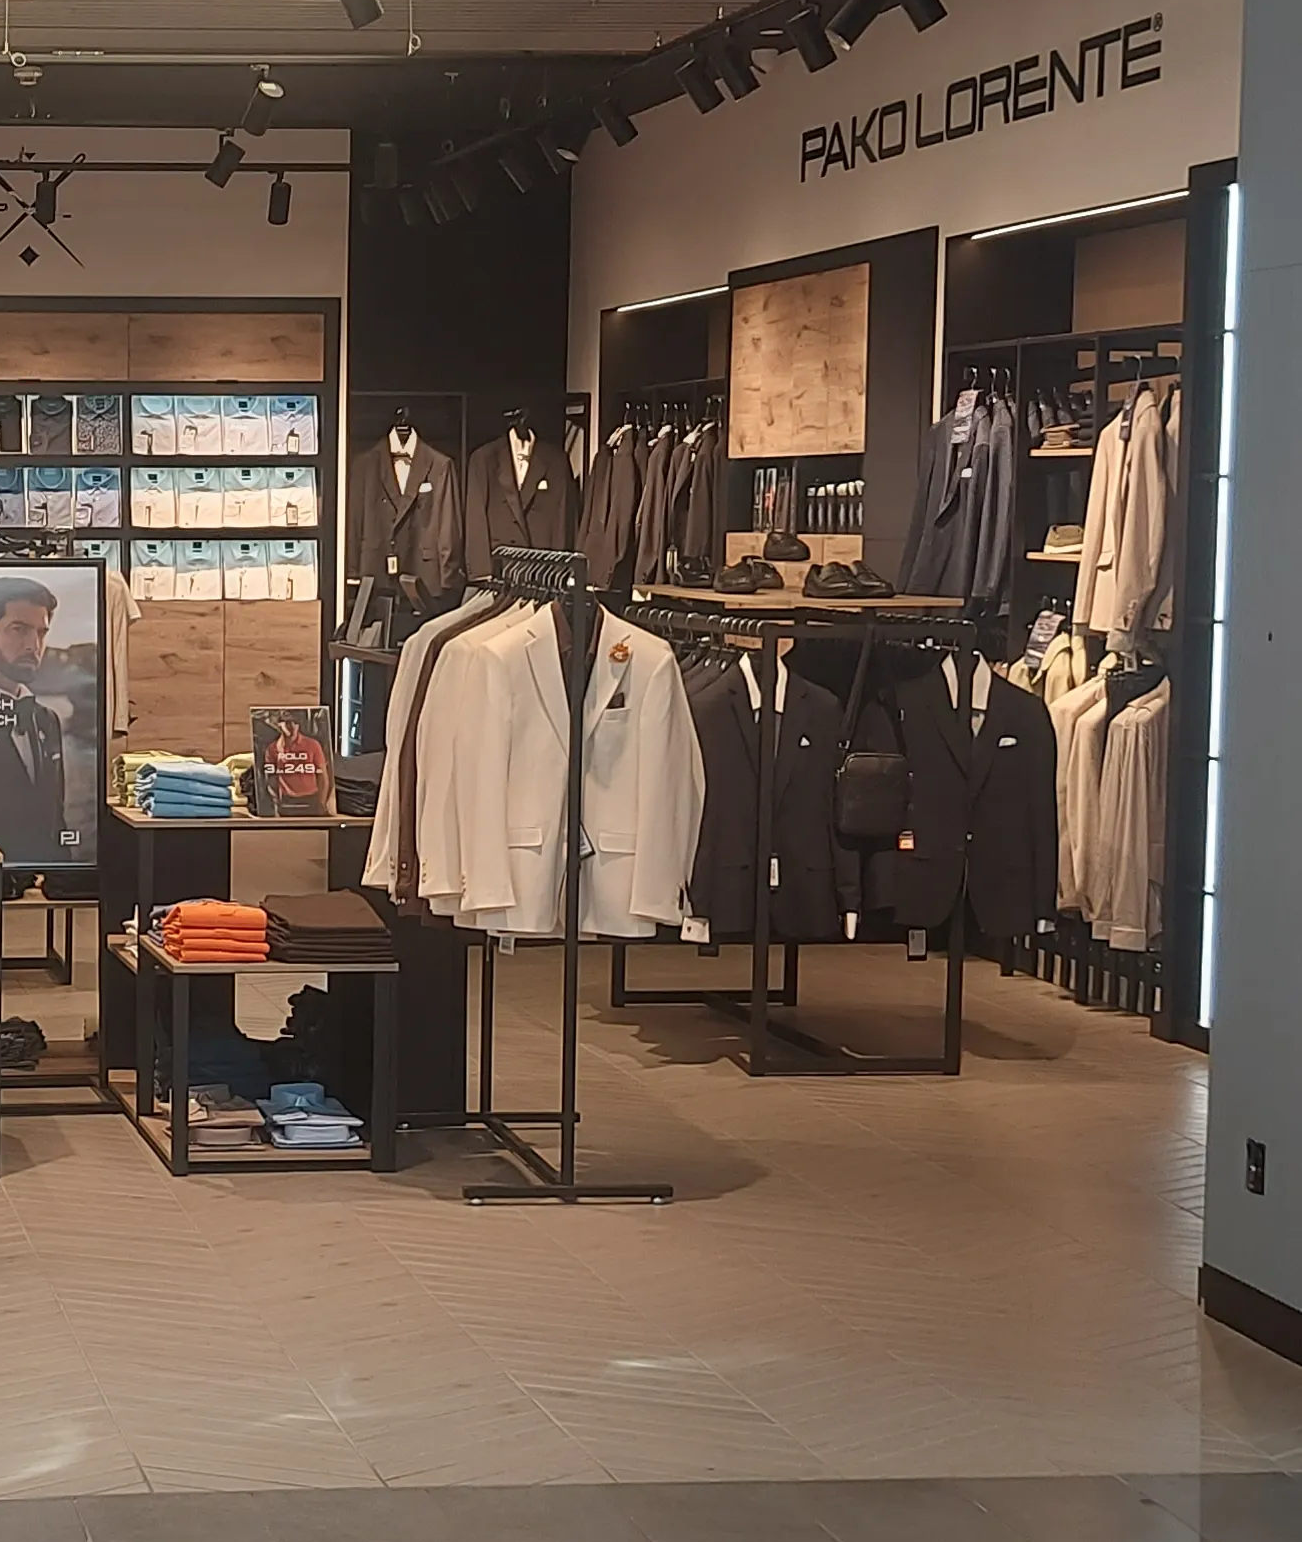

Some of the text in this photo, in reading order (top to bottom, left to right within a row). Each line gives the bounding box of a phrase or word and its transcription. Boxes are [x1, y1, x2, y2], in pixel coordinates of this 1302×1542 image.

[800, 100, 907, 183] PAKO
[278, 752, 308, 760] POLO
[284, 763, 315, 774] 249
